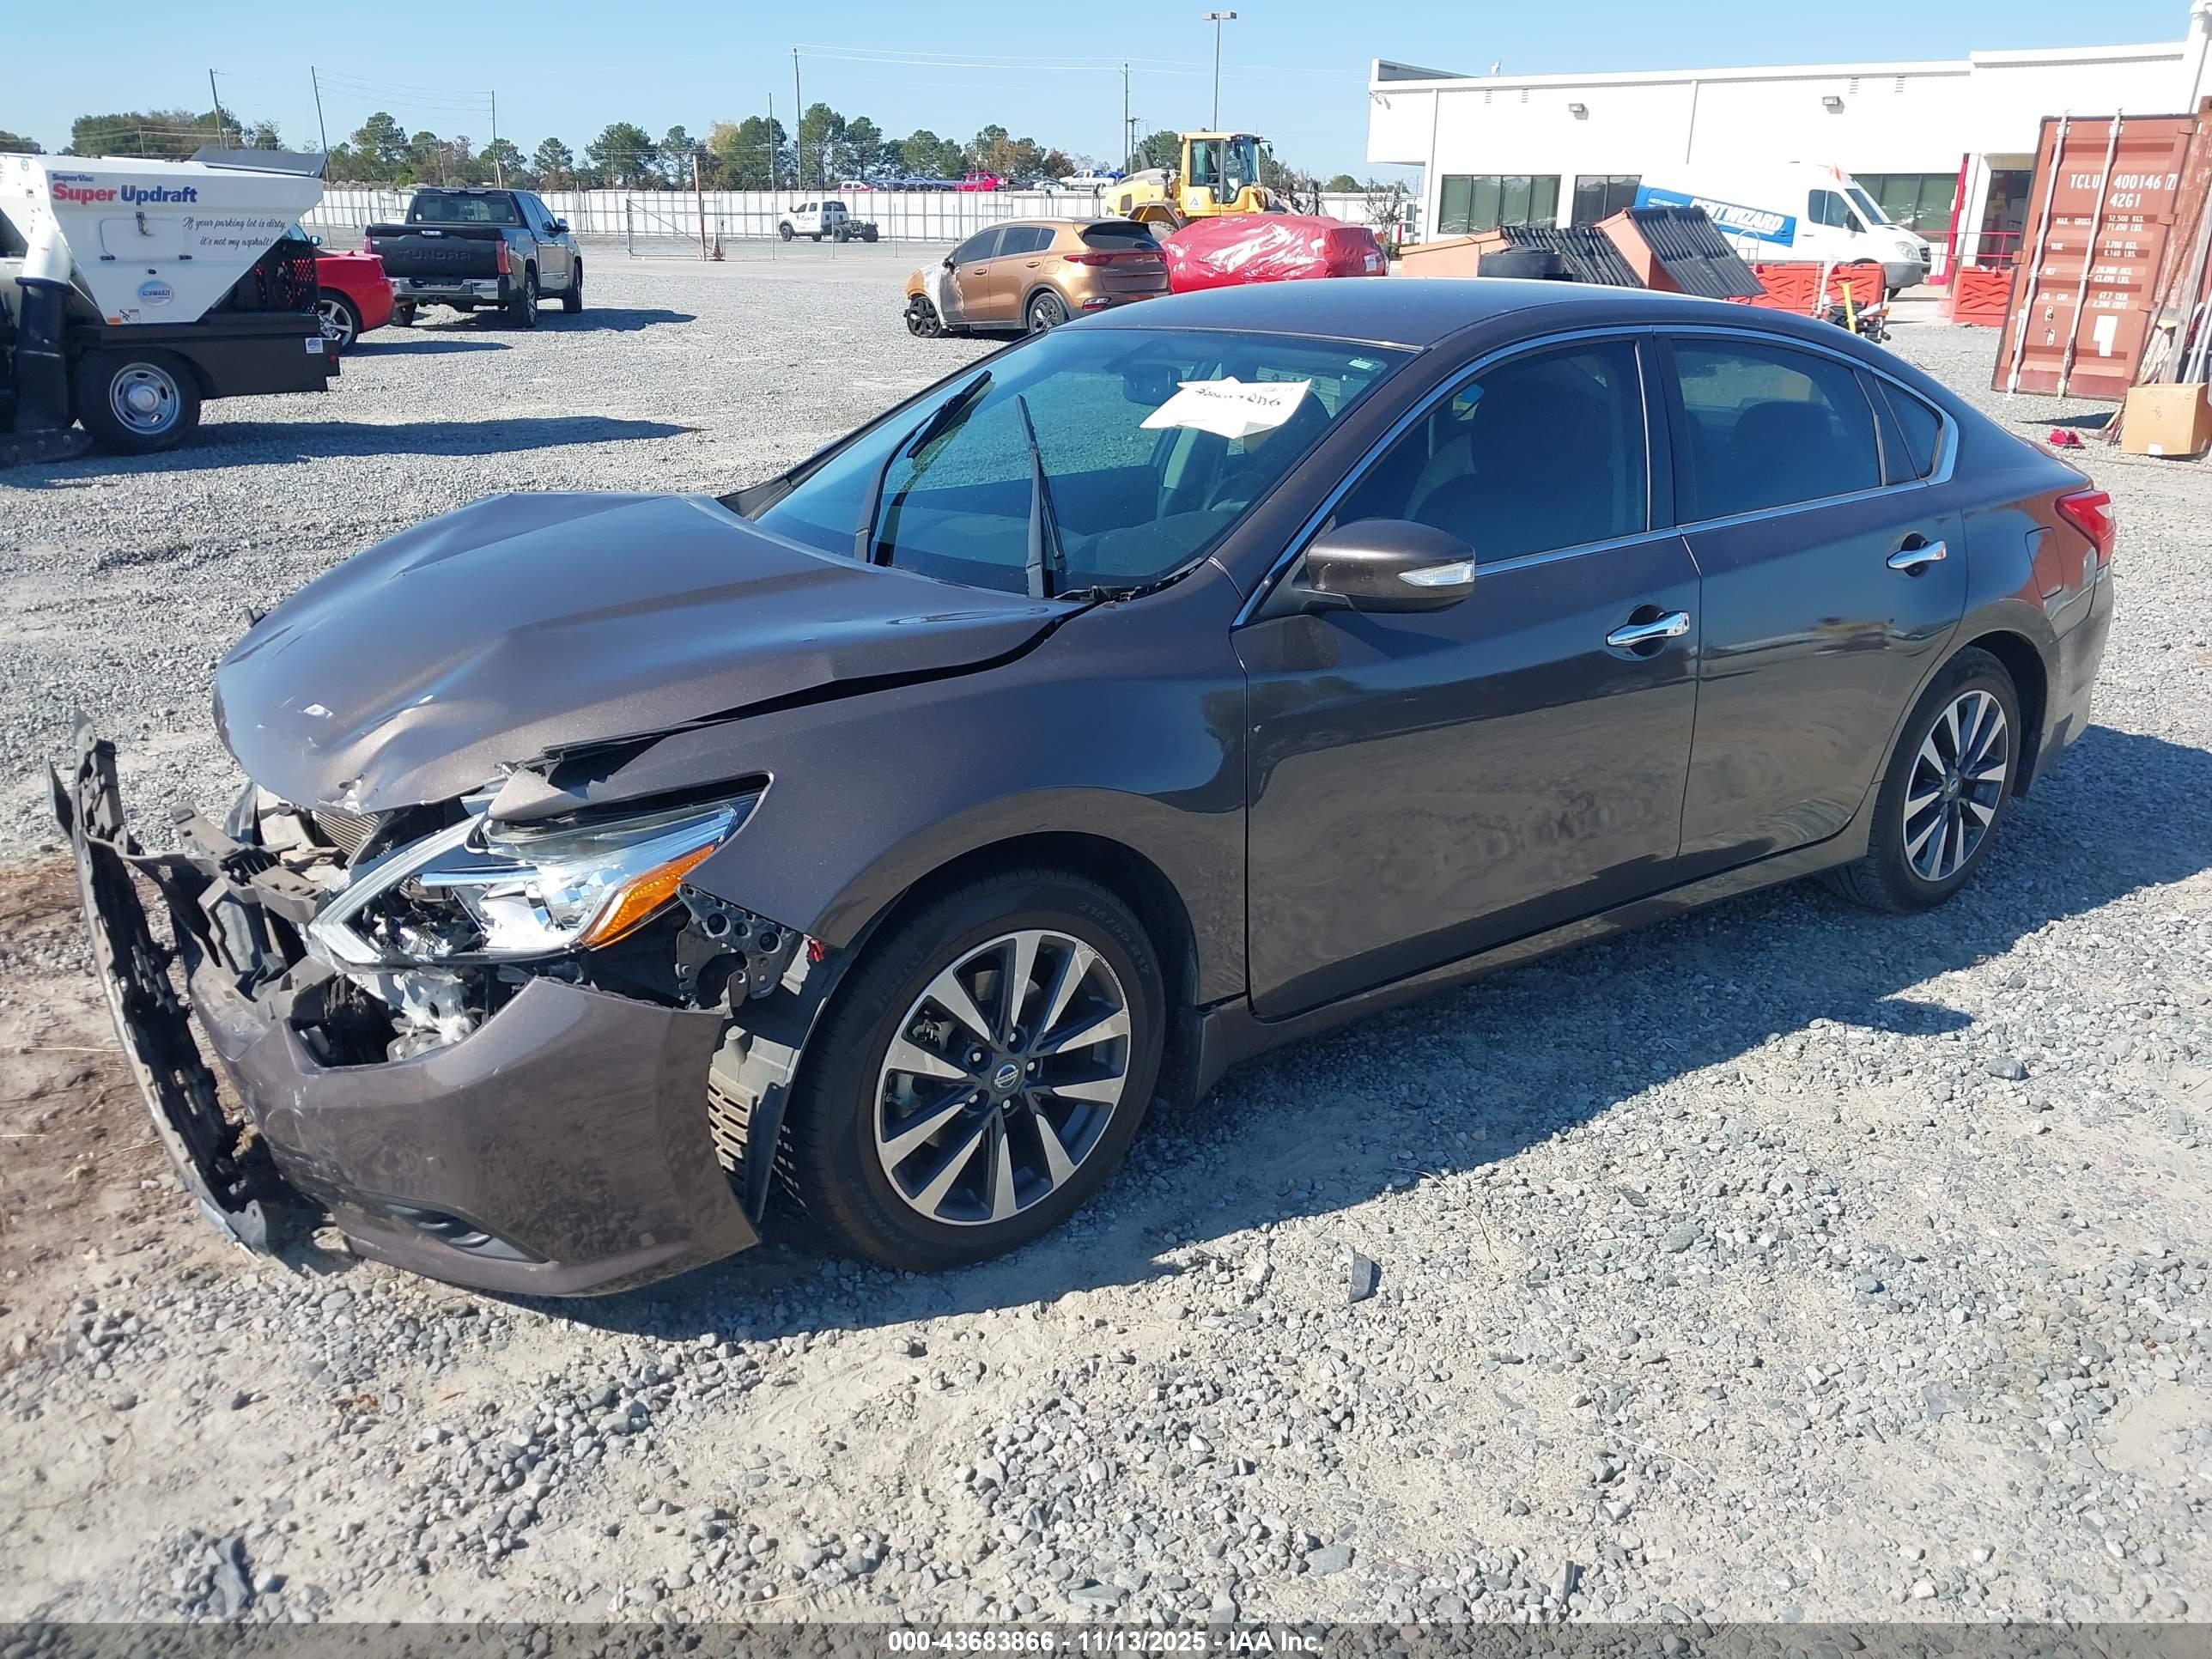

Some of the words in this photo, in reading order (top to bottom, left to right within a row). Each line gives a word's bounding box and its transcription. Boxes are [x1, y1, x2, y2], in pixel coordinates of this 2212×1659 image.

[52, 173, 94, 182] SuperVac
[2069, 173, 2100, 190] TCLU
[2113, 173, 2162, 190] 400146
[52, 182, 117, 205] Super
[120, 185, 198, 205] Updraft
[2109, 192, 2142, 208] 42G1
[182, 216, 195, 231] If
[196, 219, 213, 231] your
[213, 217, 245, 230] parking
[246, 218, 258, 228] lot
[258, 218, 264, 228] is
[199, 236, 212, 246] it's
[213, 237, 228, 246] not
[228, 240, 240, 250] my
[241, 236, 273, 248] asphalt!
